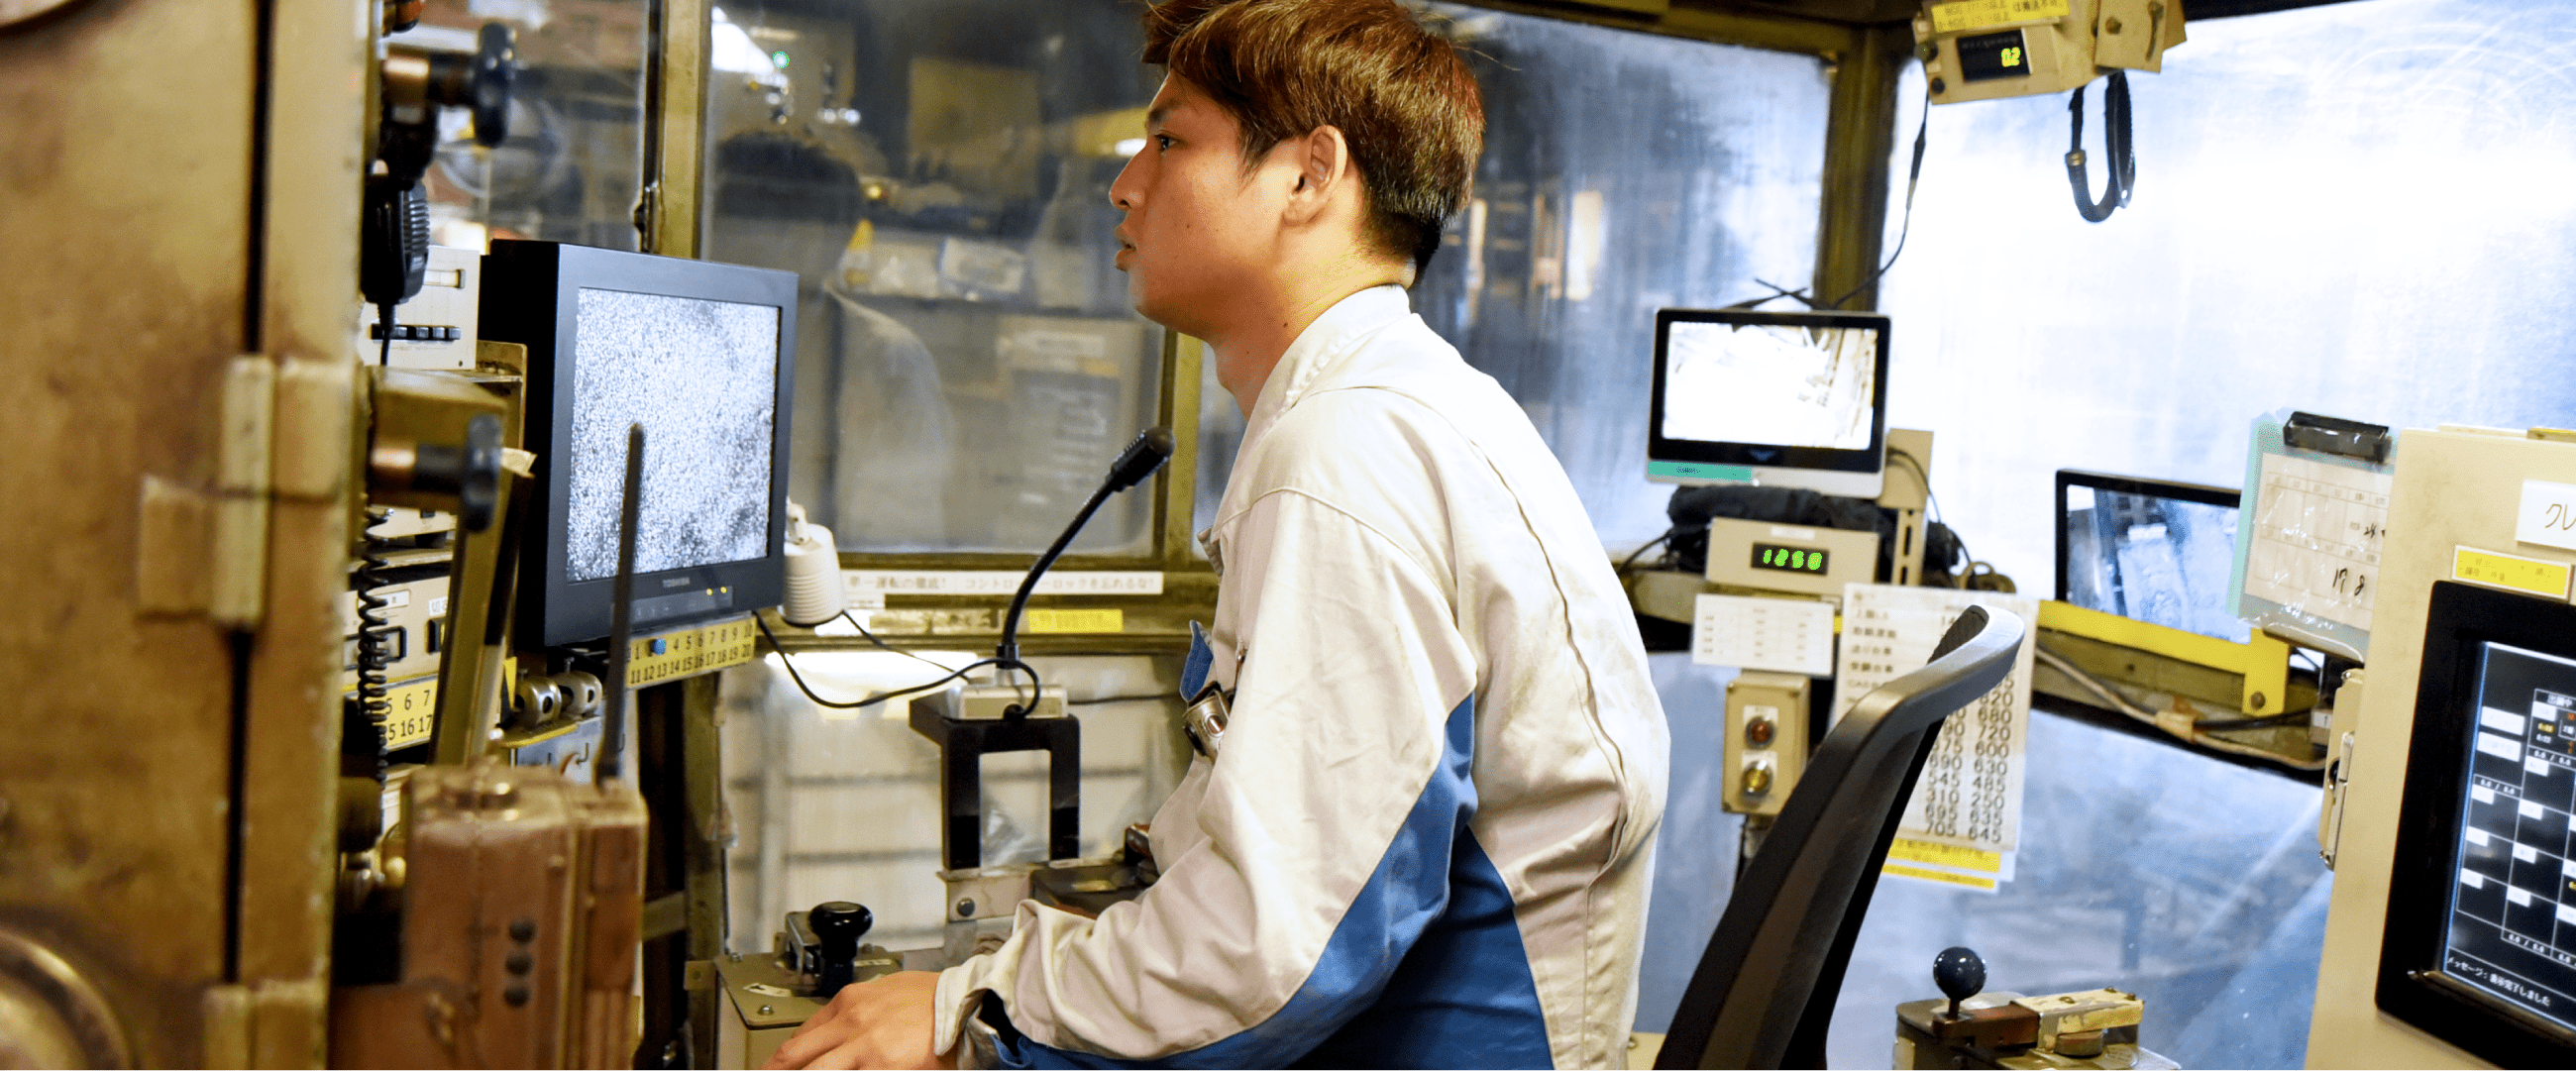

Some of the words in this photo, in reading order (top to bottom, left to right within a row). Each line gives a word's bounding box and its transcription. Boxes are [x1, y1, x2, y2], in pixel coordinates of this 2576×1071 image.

[404, 693, 412, 710] 6
[423, 690, 431, 706] 7
[400, 718, 415, 737] 16
[418, 714, 433, 733] 17
[1975, 740, 2009, 759] 600
[1968, 824, 2001, 843] 645
